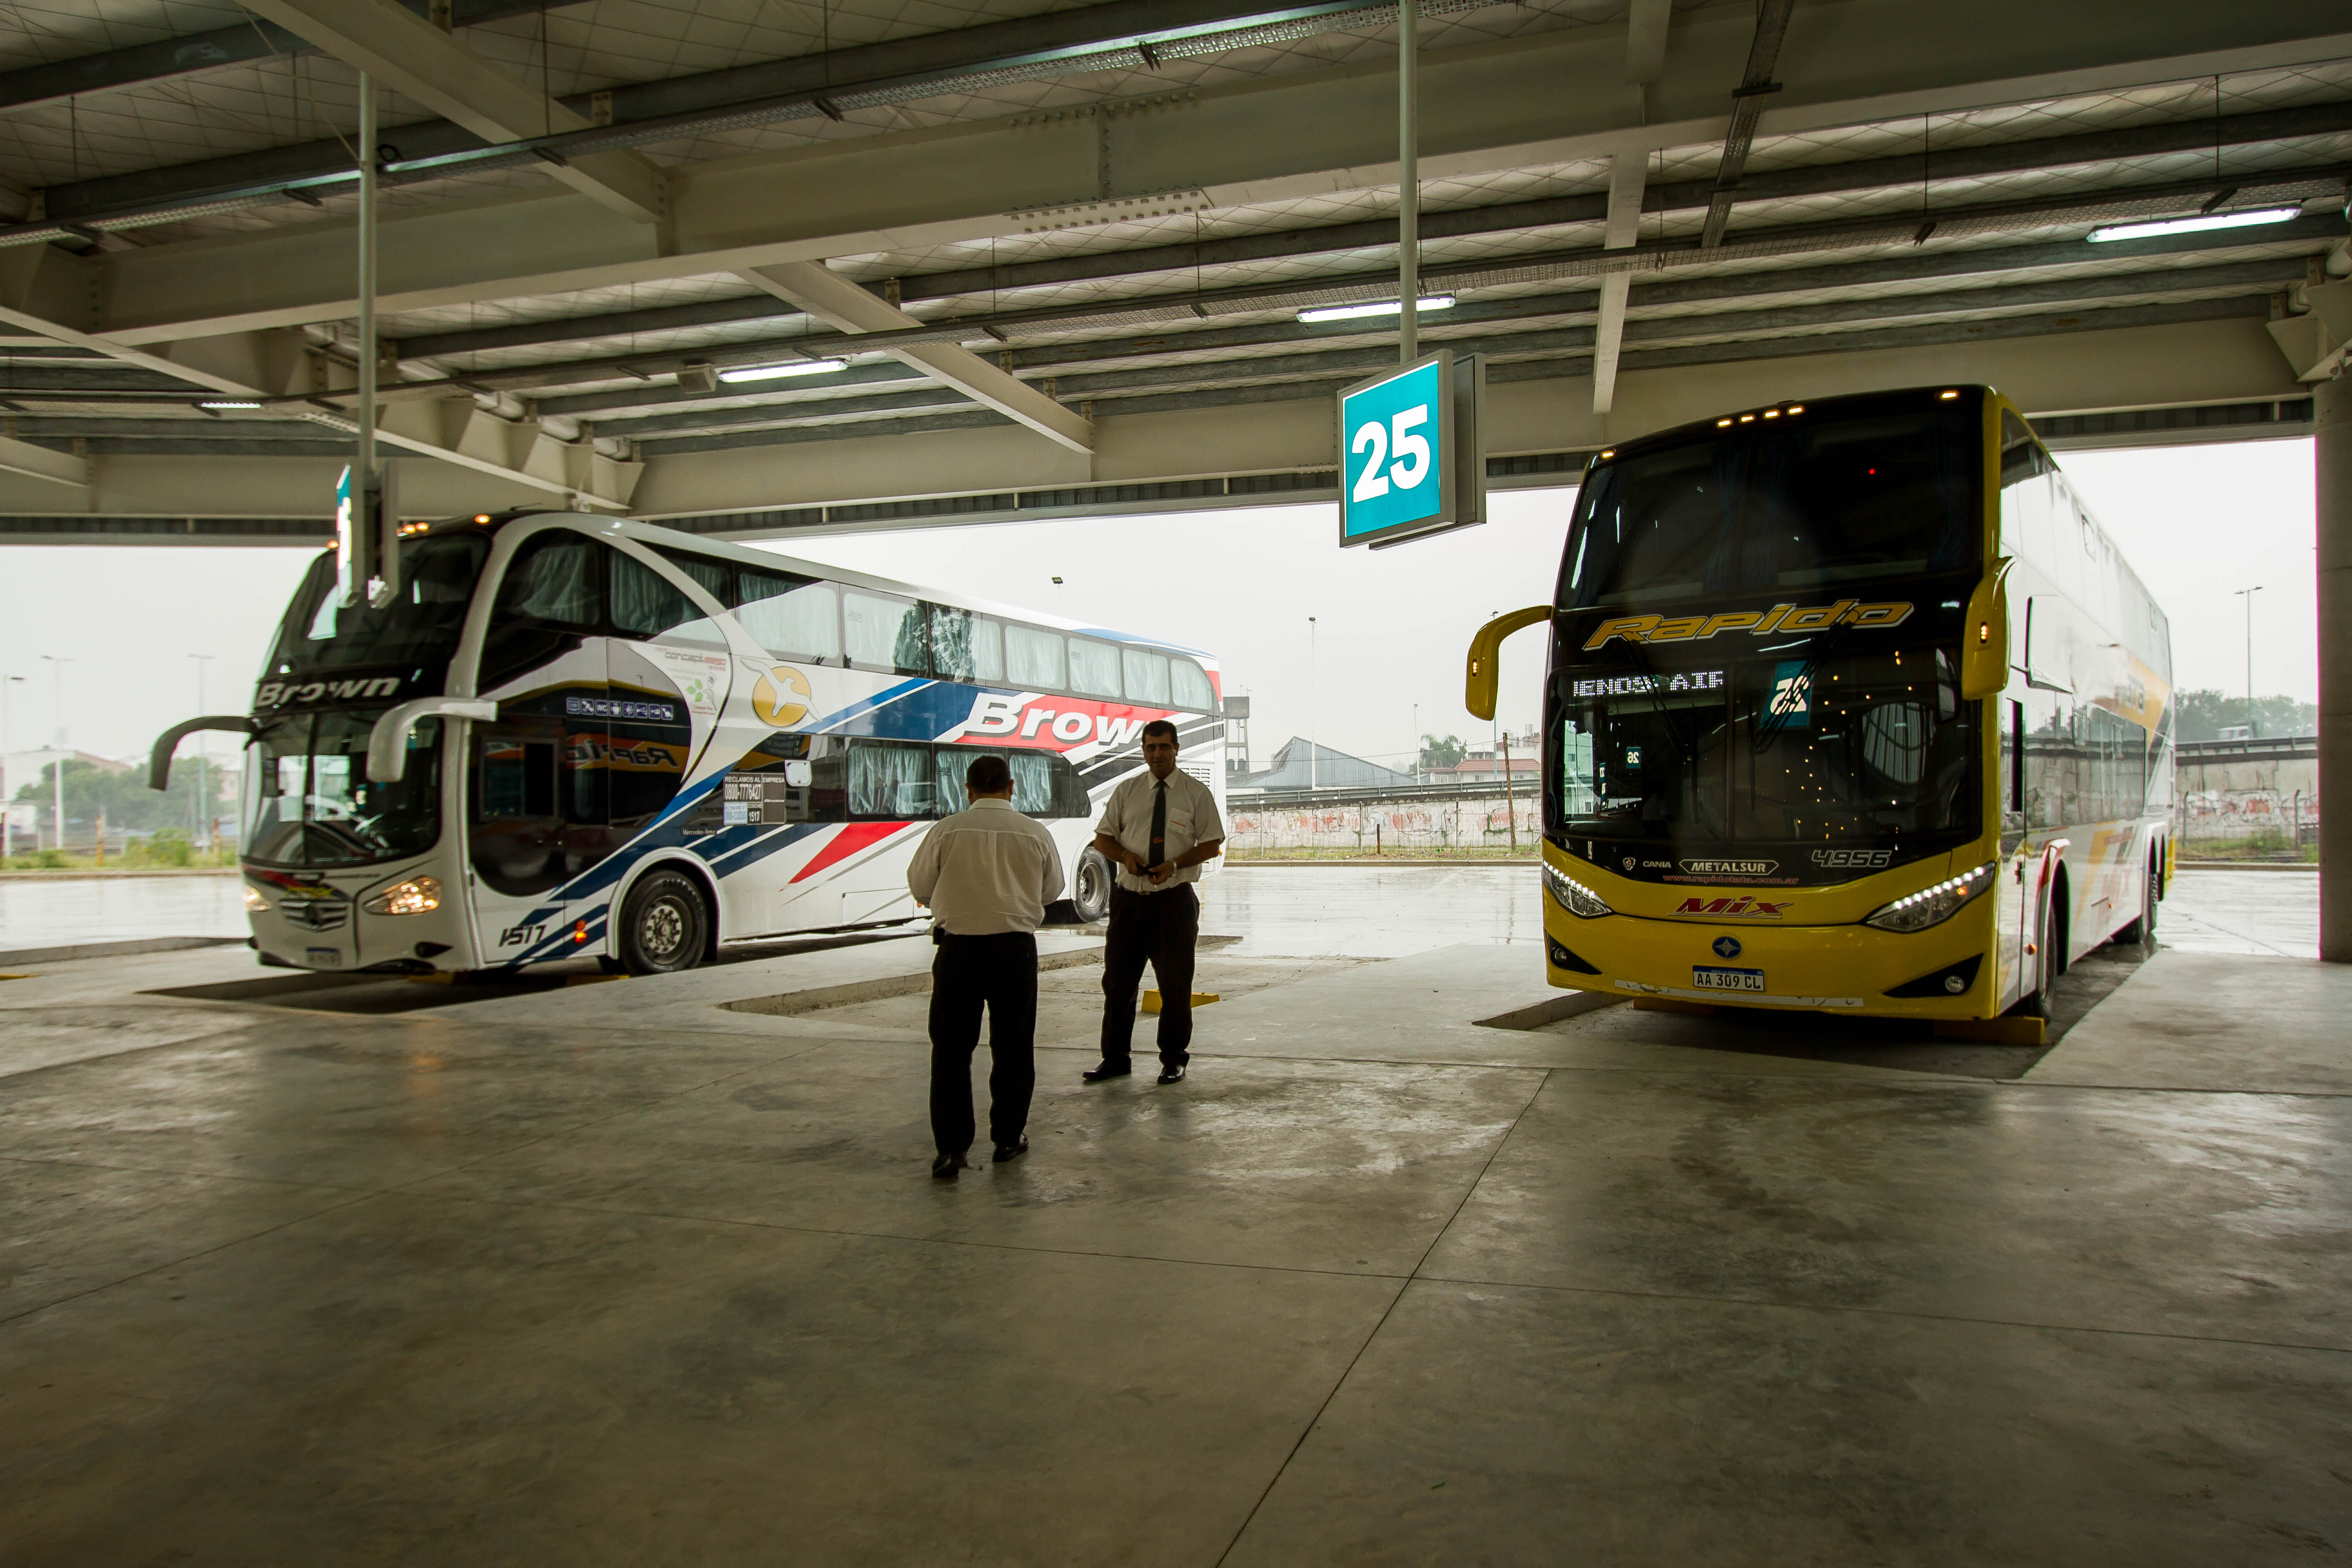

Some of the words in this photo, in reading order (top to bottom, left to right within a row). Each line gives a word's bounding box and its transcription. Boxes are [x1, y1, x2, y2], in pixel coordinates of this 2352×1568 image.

[1352, 403, 1431, 503] 25
[1582, 599, 1914, 651] Rapido
[256, 676, 401, 707] Brown
[597, 704, 607, 712] WC
[965, 692, 1147, 747] Brow
[725, 784, 761, 800] 0800-7776427
[749, 811, 760, 823] 1517
[1691, 862, 1766, 872] METALSUR
[1811, 850, 1892, 867] 4956
[1663, 875, 1799, 884] www.rapidotata.com.ar
[1675, 895, 1794, 916] Mix
[497, 924, 547, 947] 1517
[1697, 973, 1712, 986] AA
[1716, 974, 1740, 988] 309
[1744, 976, 1761, 989] CL
